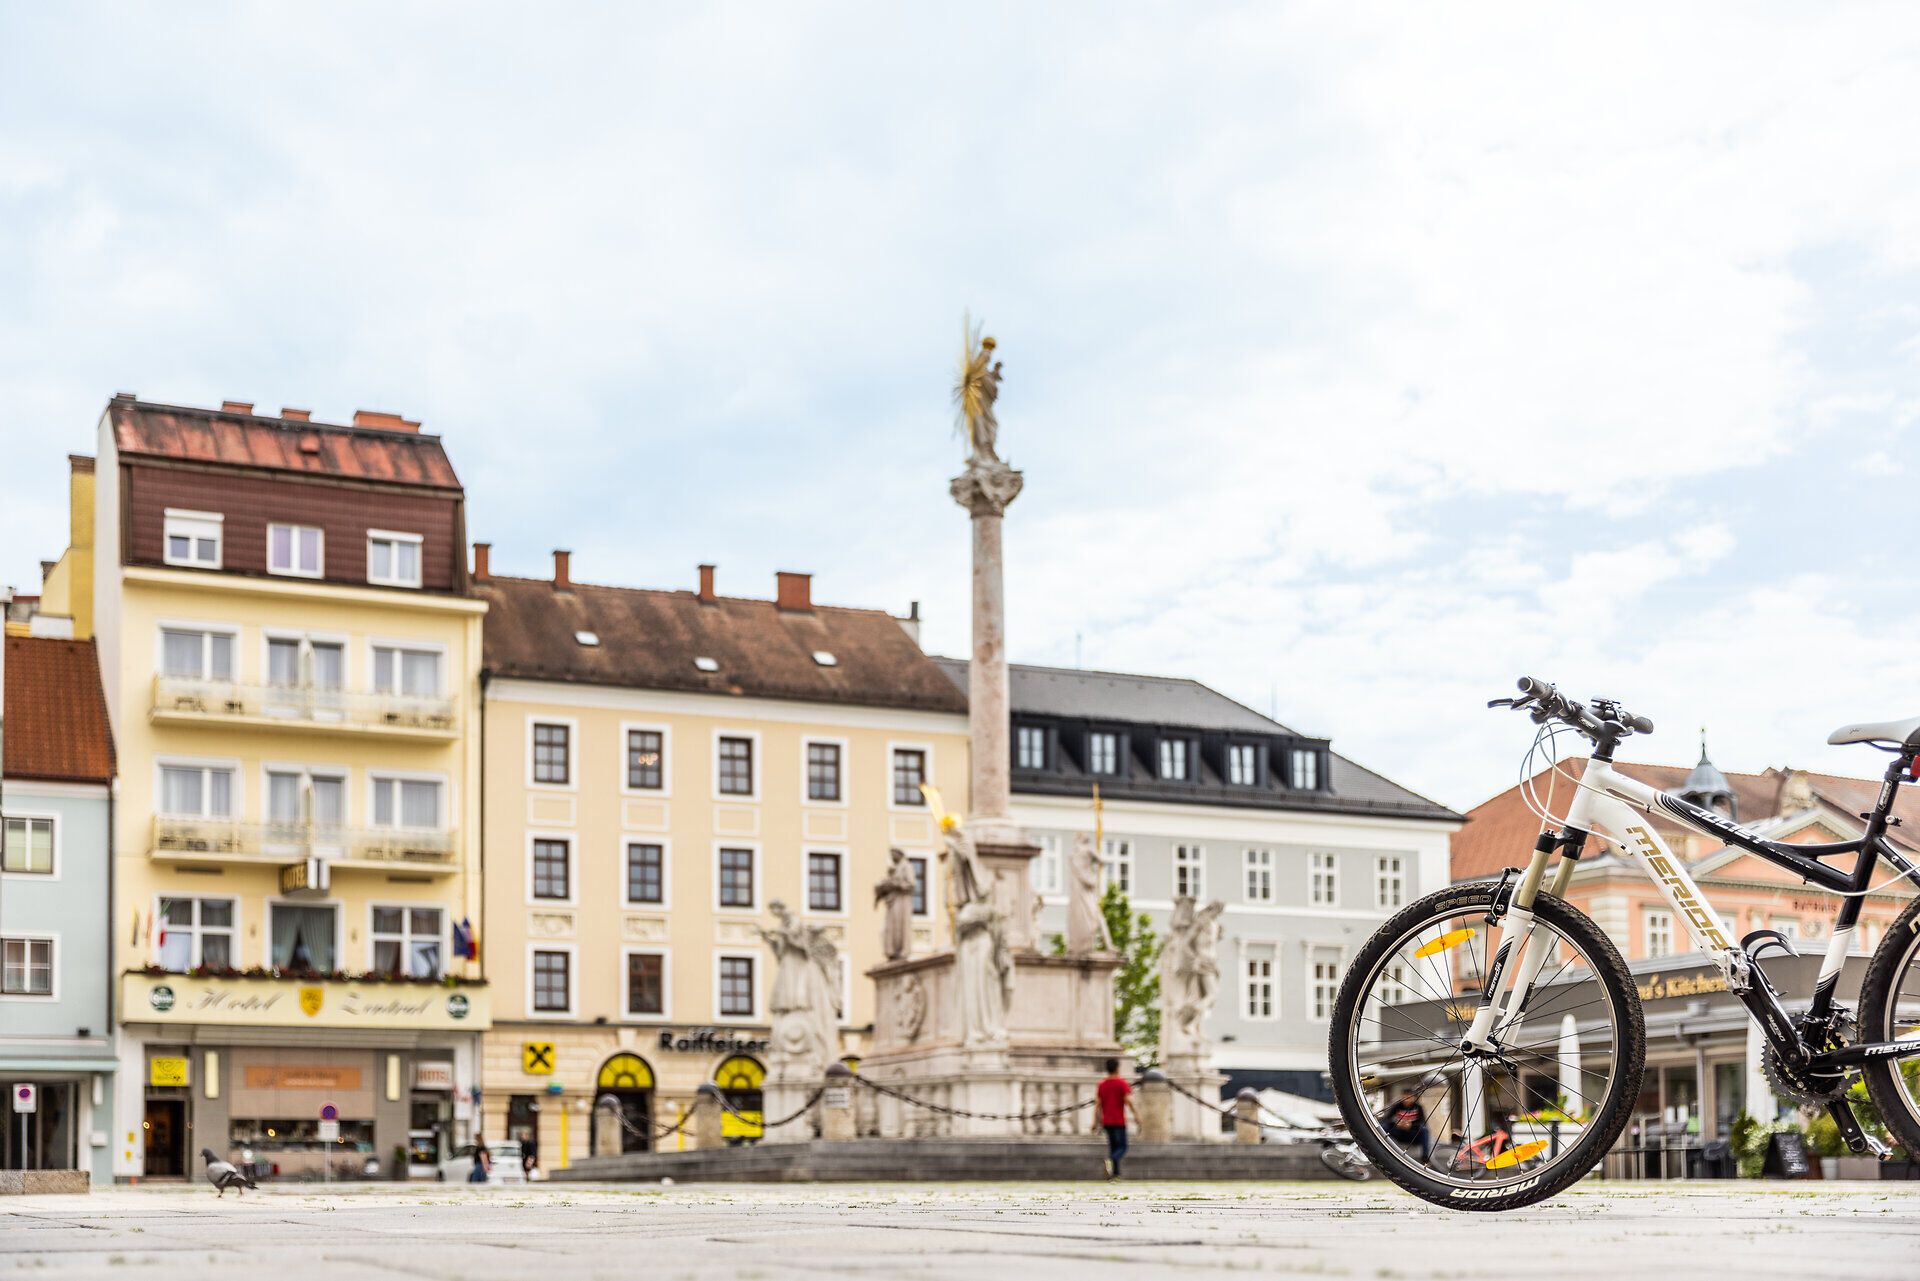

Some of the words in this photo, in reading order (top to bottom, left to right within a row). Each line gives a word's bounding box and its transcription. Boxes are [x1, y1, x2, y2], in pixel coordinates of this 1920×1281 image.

[1434, 894, 1492, 912] SPEED
[1626, 826, 1729, 951] MERIDA
[1487, 961, 1503, 998] MERIDA
[1450, 1174, 1541, 1199] MERIDA
